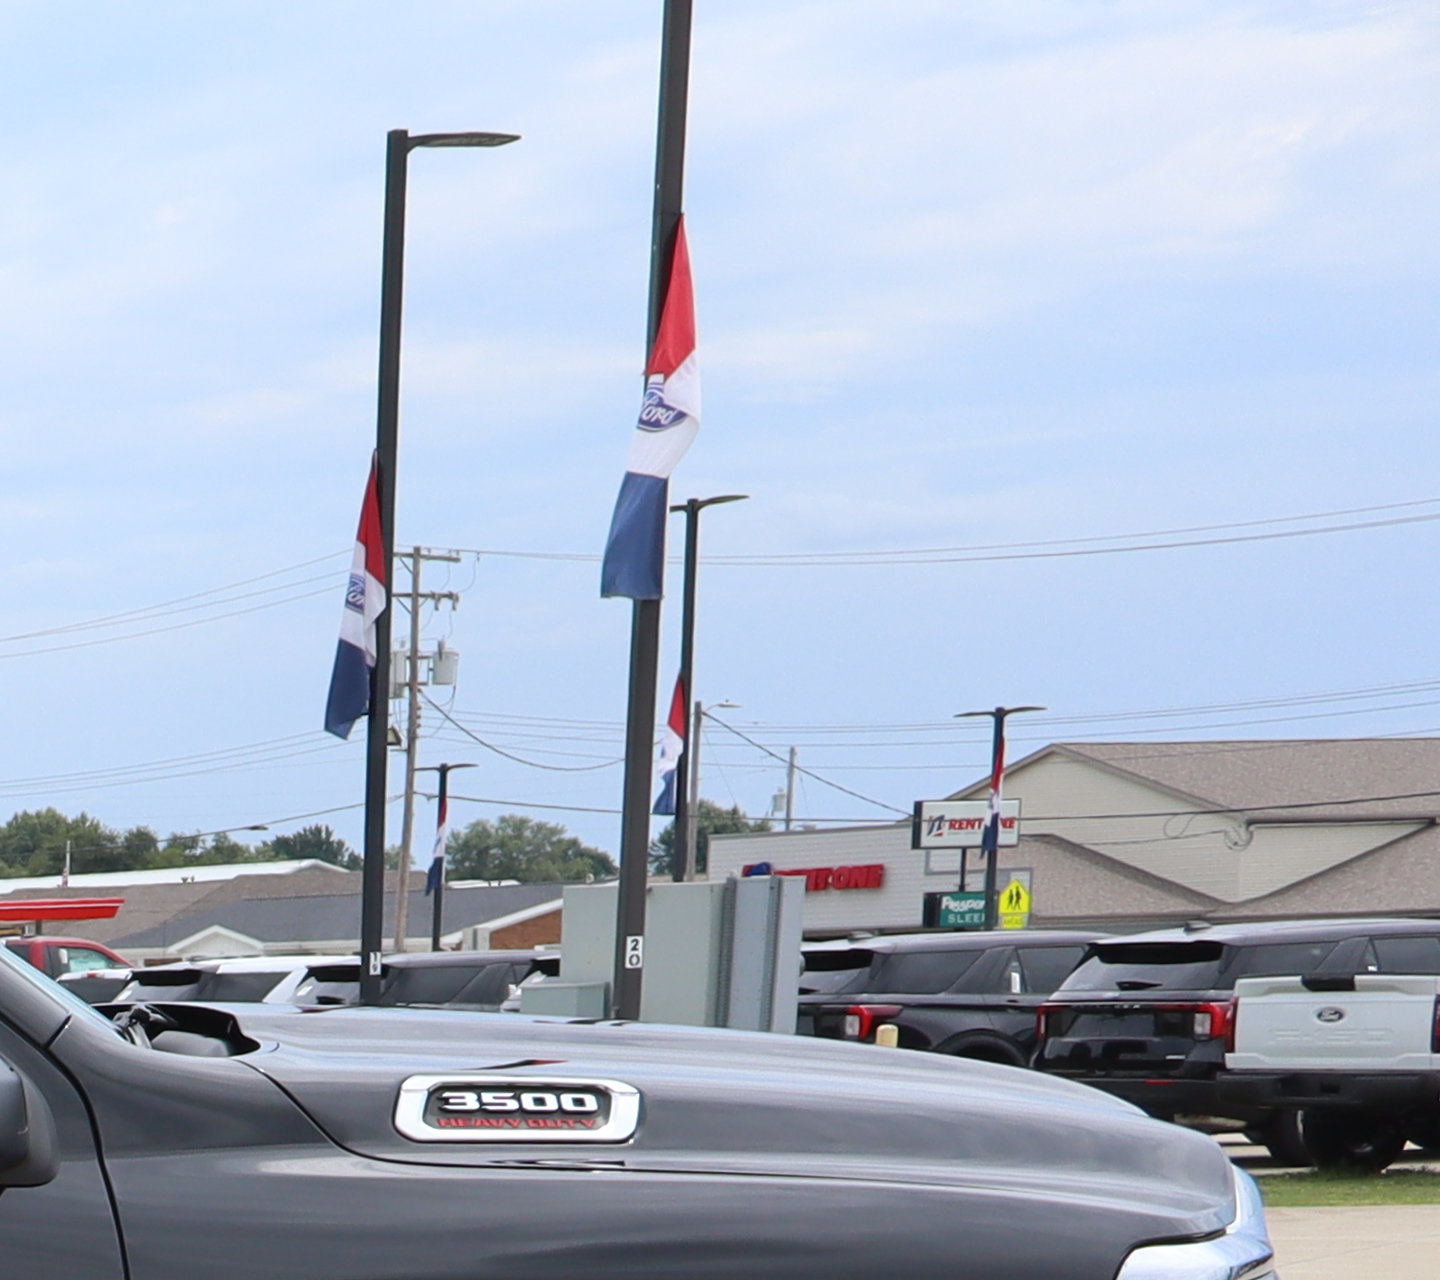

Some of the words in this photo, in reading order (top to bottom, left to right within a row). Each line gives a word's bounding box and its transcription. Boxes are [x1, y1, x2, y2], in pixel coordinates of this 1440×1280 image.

[947, 817, 985, 831] RENT
[999, 816, 1017, 830] NE
[941, 895, 986, 912] Passpor
[947, 912, 985, 924] SLEE
[439, 1090, 600, 1114] 3500
[436, 1117, 521, 1129] HEAVY
[528, 1118, 598, 1129] DUTY
